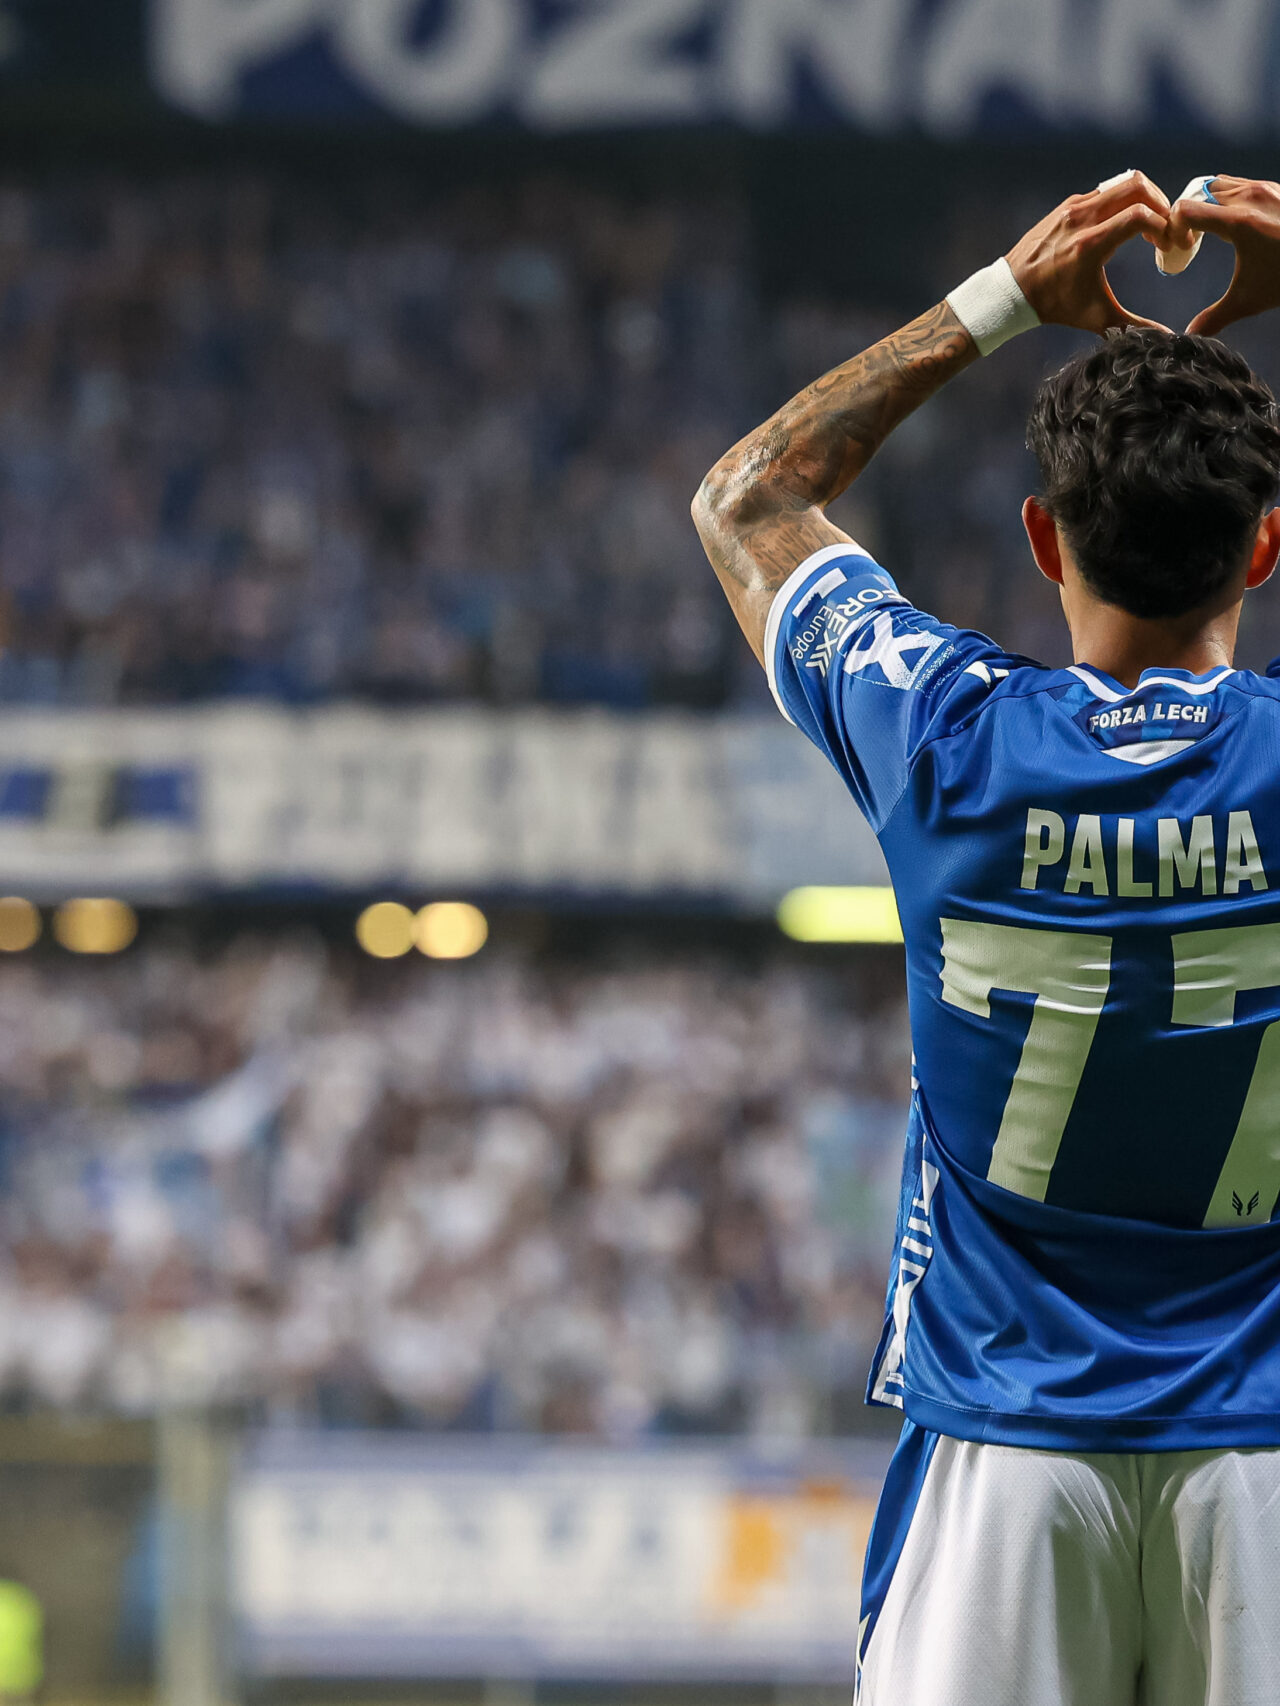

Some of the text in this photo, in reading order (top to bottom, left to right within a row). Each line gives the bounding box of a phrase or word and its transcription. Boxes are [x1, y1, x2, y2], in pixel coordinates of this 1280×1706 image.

[791, 605, 832, 660] Europe
[1089, 703, 1208, 733] FORZA LECH
[1020, 807, 1269, 898] PALMA
